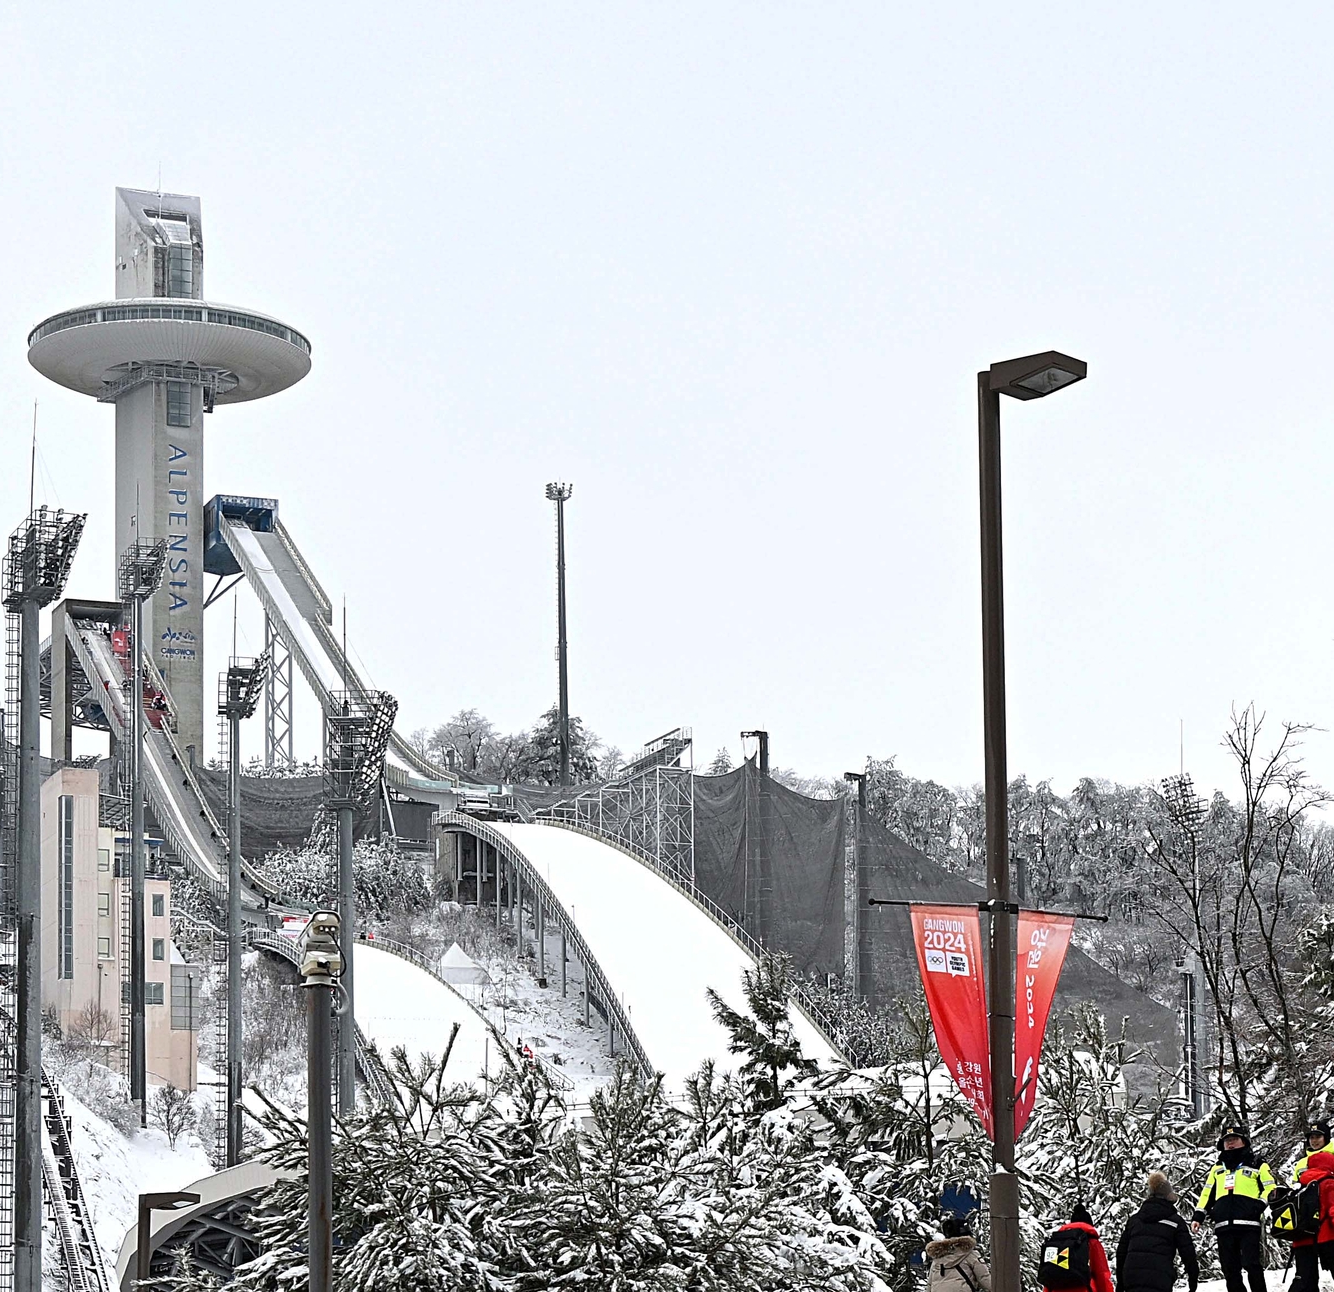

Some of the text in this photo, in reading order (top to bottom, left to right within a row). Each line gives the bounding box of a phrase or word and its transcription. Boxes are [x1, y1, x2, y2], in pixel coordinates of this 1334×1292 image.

[168, 444, 188, 611] ALPENSIA
[923, 918, 965, 933] GANGWON
[924, 930, 966, 952] 2024
[1025, 974, 1036, 1029] 2024
